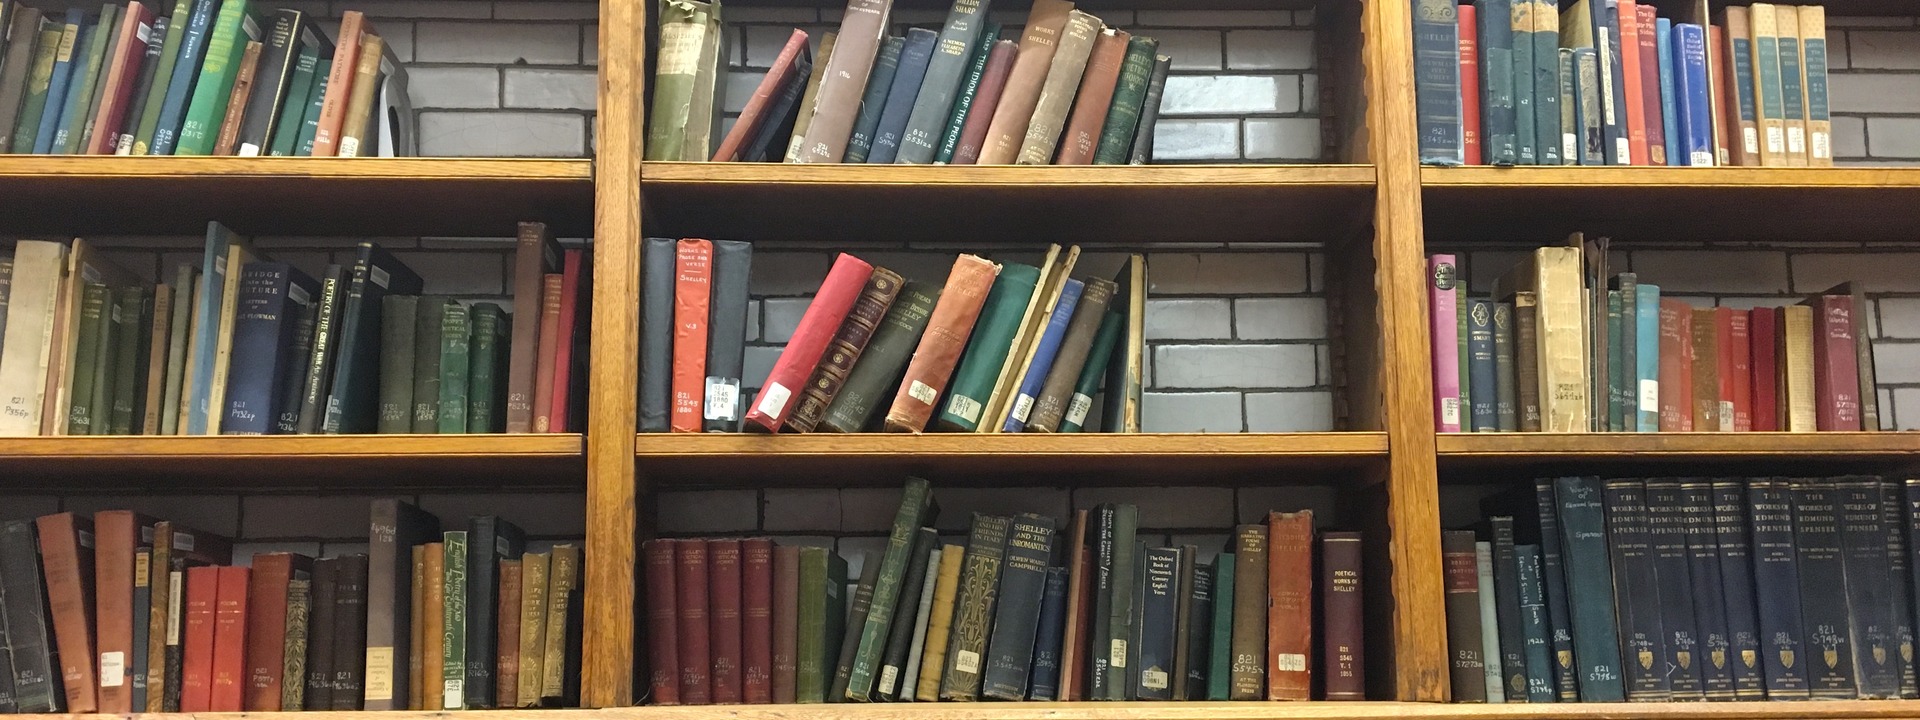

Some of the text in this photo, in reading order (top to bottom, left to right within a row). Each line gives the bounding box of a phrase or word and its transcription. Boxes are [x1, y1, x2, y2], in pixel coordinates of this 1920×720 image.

[954, 6, 976, 14] SHARP
[1035, 26, 1055, 36] WORKS
[1069, 31, 1087, 41] SHELLEY
[1028, 35, 1053, 47] SHELLEY
[943, 54, 987, 156] THE IDIOM OF THE PEOPLE
[912, 128, 928, 139] 821
[1034, 123, 1051, 136] 821
[1431, 127, 1446, 135] 821
[854, 132, 868, 141] 821
[325, 278, 336, 305] POETRY
[913, 291, 932, 304] POEMS
[324, 306, 331, 314] OF
[320, 317, 330, 331] THE
[318, 331, 327, 350] GREAT
[314, 366, 321, 374] An
[308, 376, 320, 404] Anthology
[676, 391, 690, 399] 821
[10, 396, 25, 404] 821
[510, 392, 525, 402] 821
[848, 391, 863, 404] 821
[1047, 395, 1059, 406] 821
[232, 400, 246, 408] 821
[677, 399, 699, 407] S545
[280, 412, 298, 422] 821
[1798, 504, 1833, 512] WORKS OF
[974, 528, 1004, 537] FRIENDS
[1014, 523, 1053, 536] SHELLEY
[379, 534, 393, 543] 821
[983, 535, 1001, 543] ITALY
[1016, 532, 1047, 542] AND THE
[1272, 544, 1310, 552] SHELLEY
[448, 539, 465, 568] English
[1009, 555, 1046, 566] OLWEN WARD
[1009, 562, 1045, 573] CAMPBELL
[1149, 568, 1172, 576] Nineteenth
[450, 568, 465, 594] Poetry
[444, 583, 452, 594] Late
[454, 602, 462, 610] the
[444, 596, 454, 630] Eighteenth
[453, 610, 462, 622] Mid
[1818, 625, 1834, 634] 821
[1812, 635, 1844, 644] S748w
[443, 632, 454, 658] Century
[1238, 654, 1256, 664] 821
[1459, 650, 1477, 659] 821
[337, 672, 351, 680] 821
